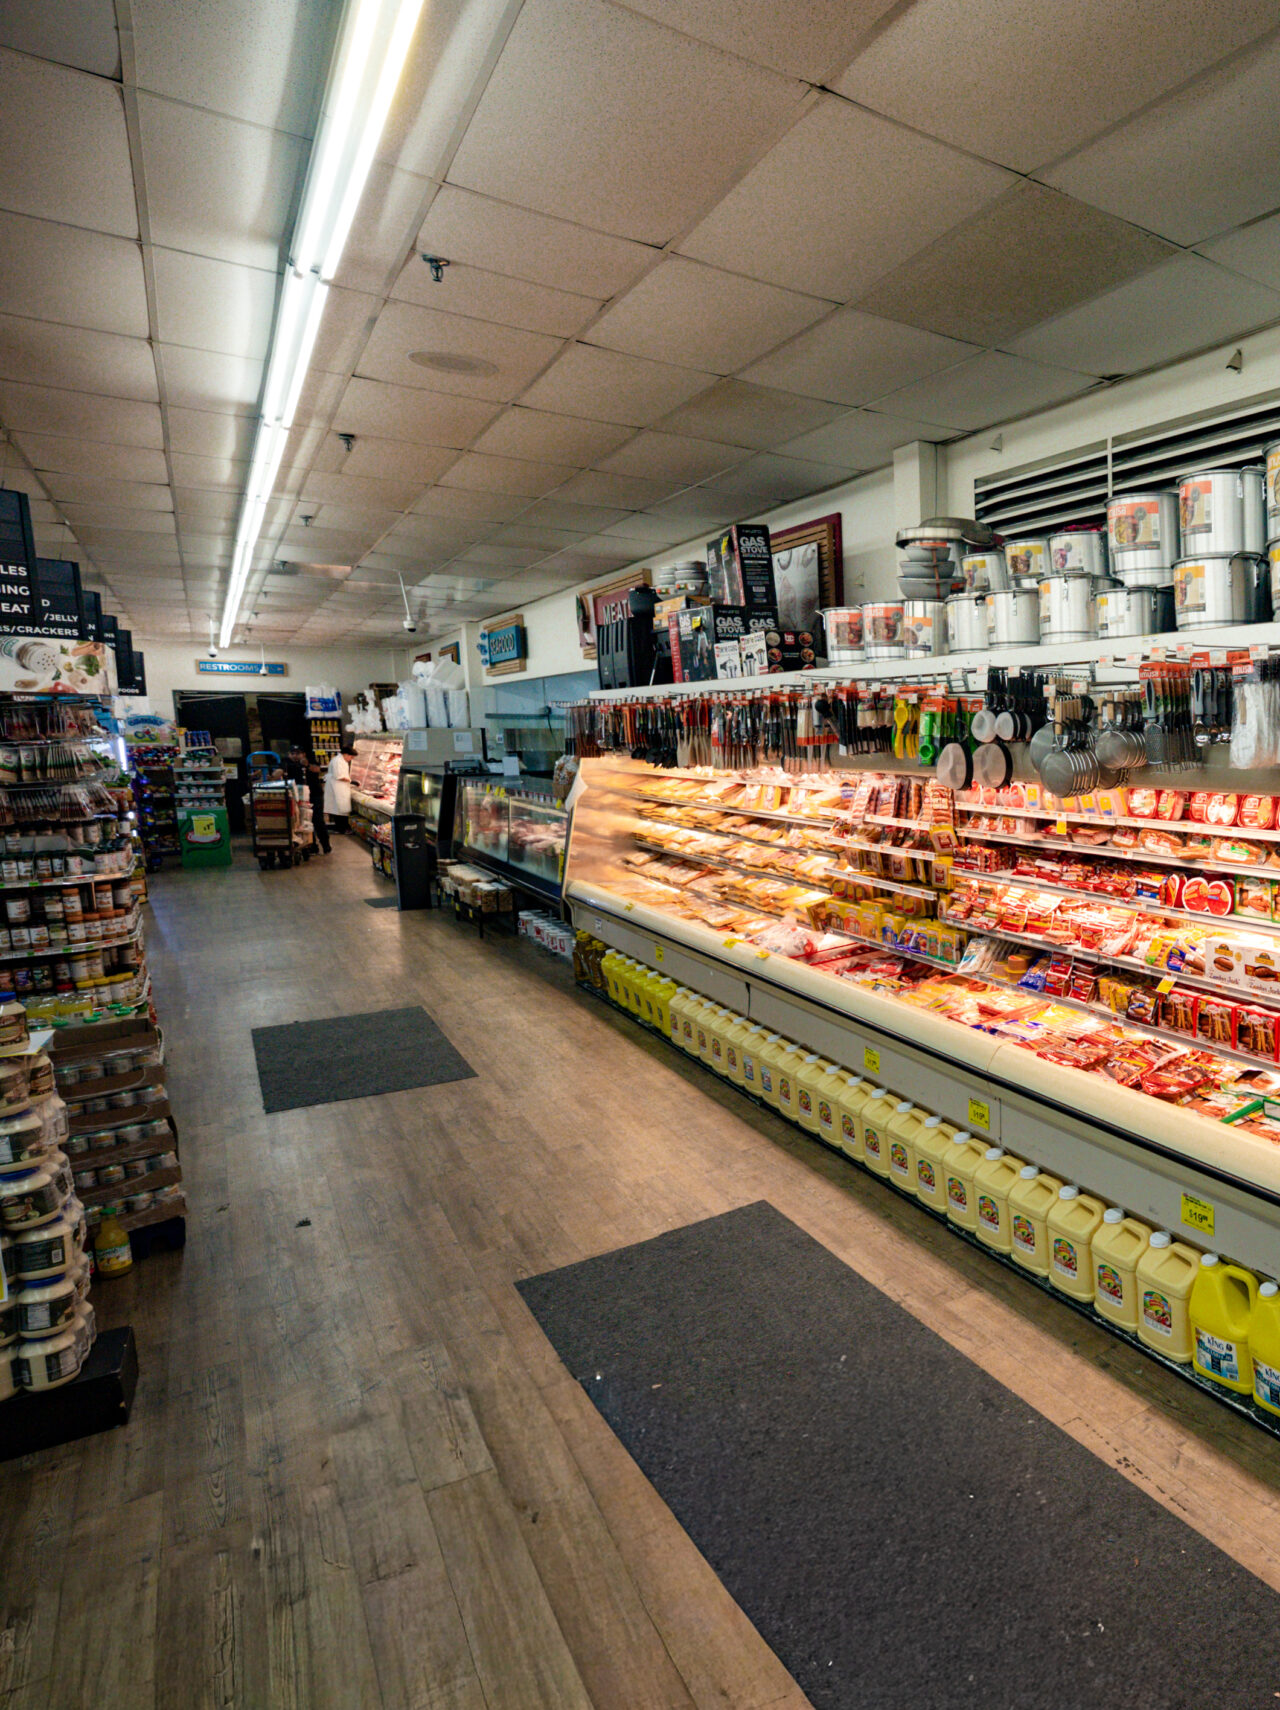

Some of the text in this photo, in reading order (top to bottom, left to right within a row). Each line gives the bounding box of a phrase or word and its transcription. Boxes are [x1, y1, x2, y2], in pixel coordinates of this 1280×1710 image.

[740, 536, 765, 547] GAS
[0, 585, 30, 596] ING
[44, 613, 79, 623] /JELLY
[716, 617, 743, 627] GAS
[749, 618, 776, 629] GAS
[716, 626, 745, 634] STOVE
[199, 663, 259, 672] RESTROOMS
[1207, 1336, 1224, 1351] KING
